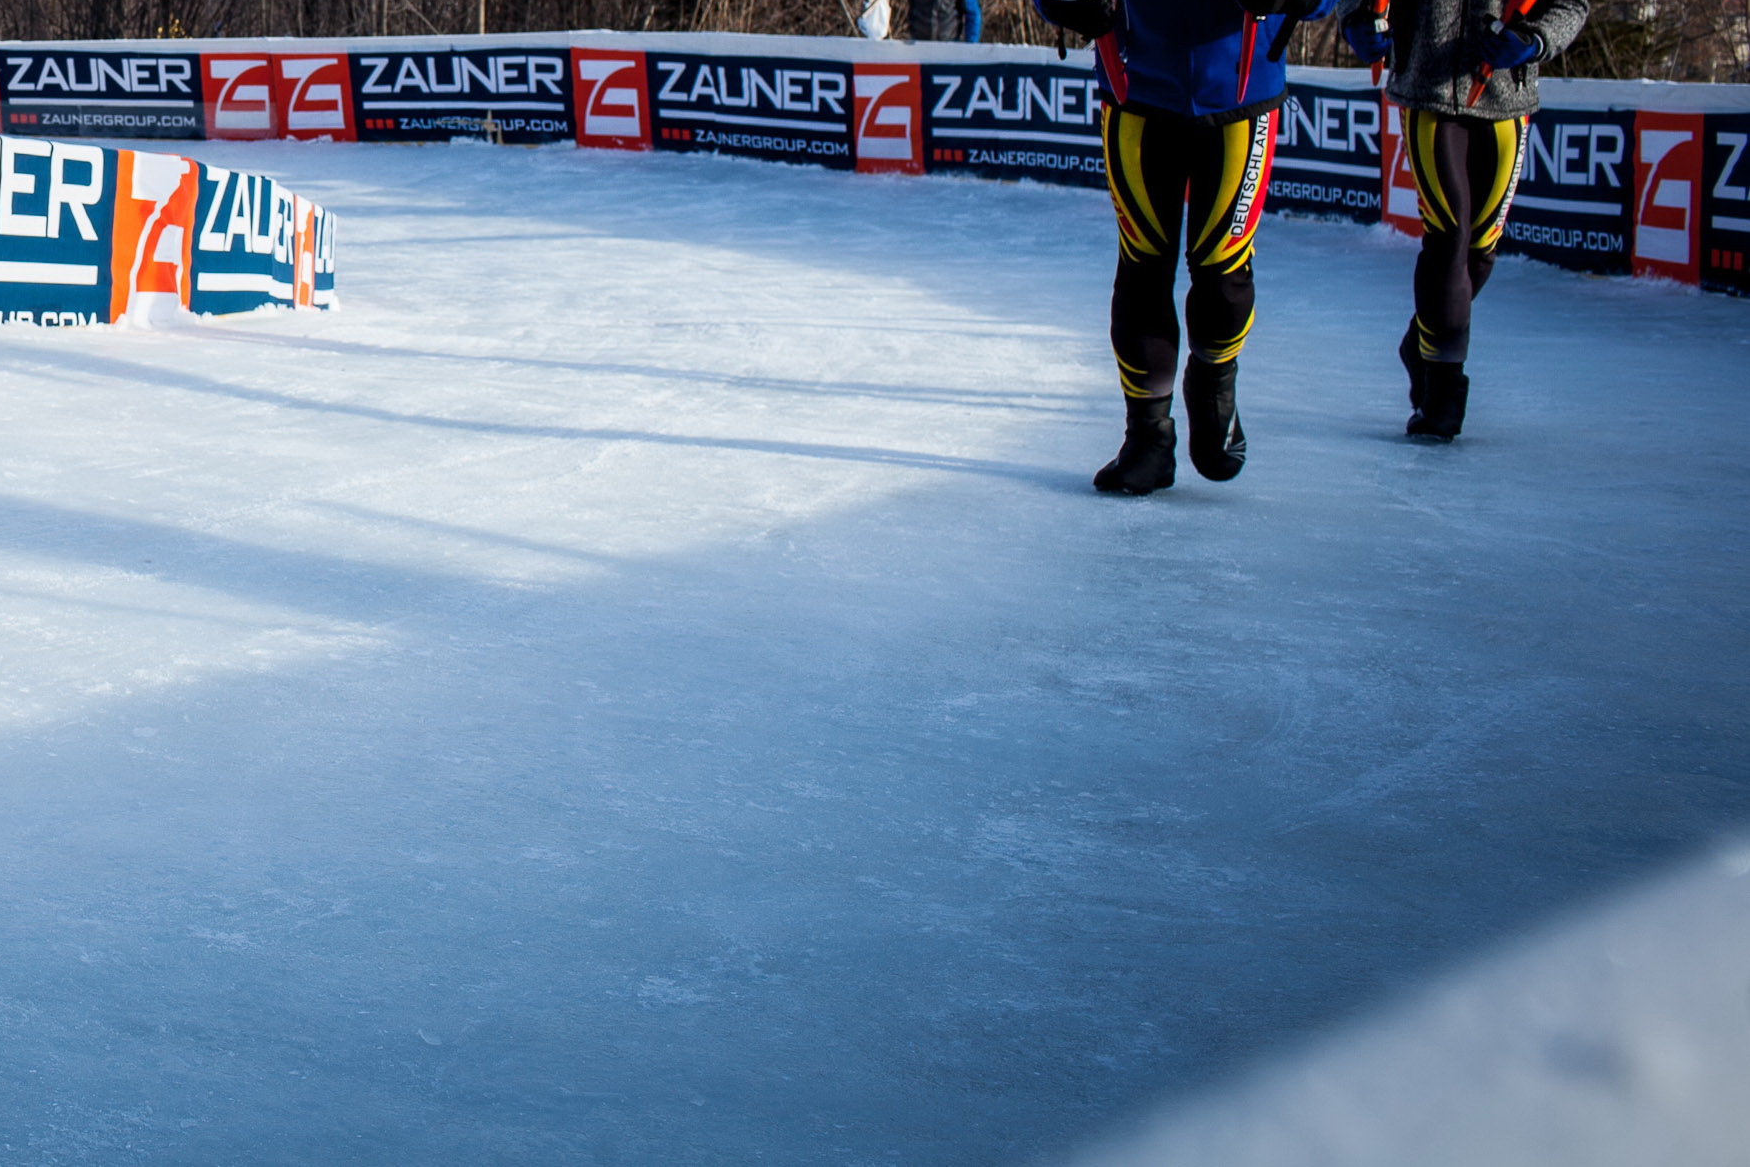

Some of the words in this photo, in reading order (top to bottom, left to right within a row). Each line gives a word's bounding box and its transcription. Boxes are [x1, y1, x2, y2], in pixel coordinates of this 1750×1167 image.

[6, 56, 193, 94] ZAUNER
[360, 55, 565, 95] ZAUNER
[657, 61, 847, 115] ZAUNER
[41, 112, 197, 129] ZAUNERGROUP.COM
[1231, 112, 1269, 237] DEUTSCHLAND
